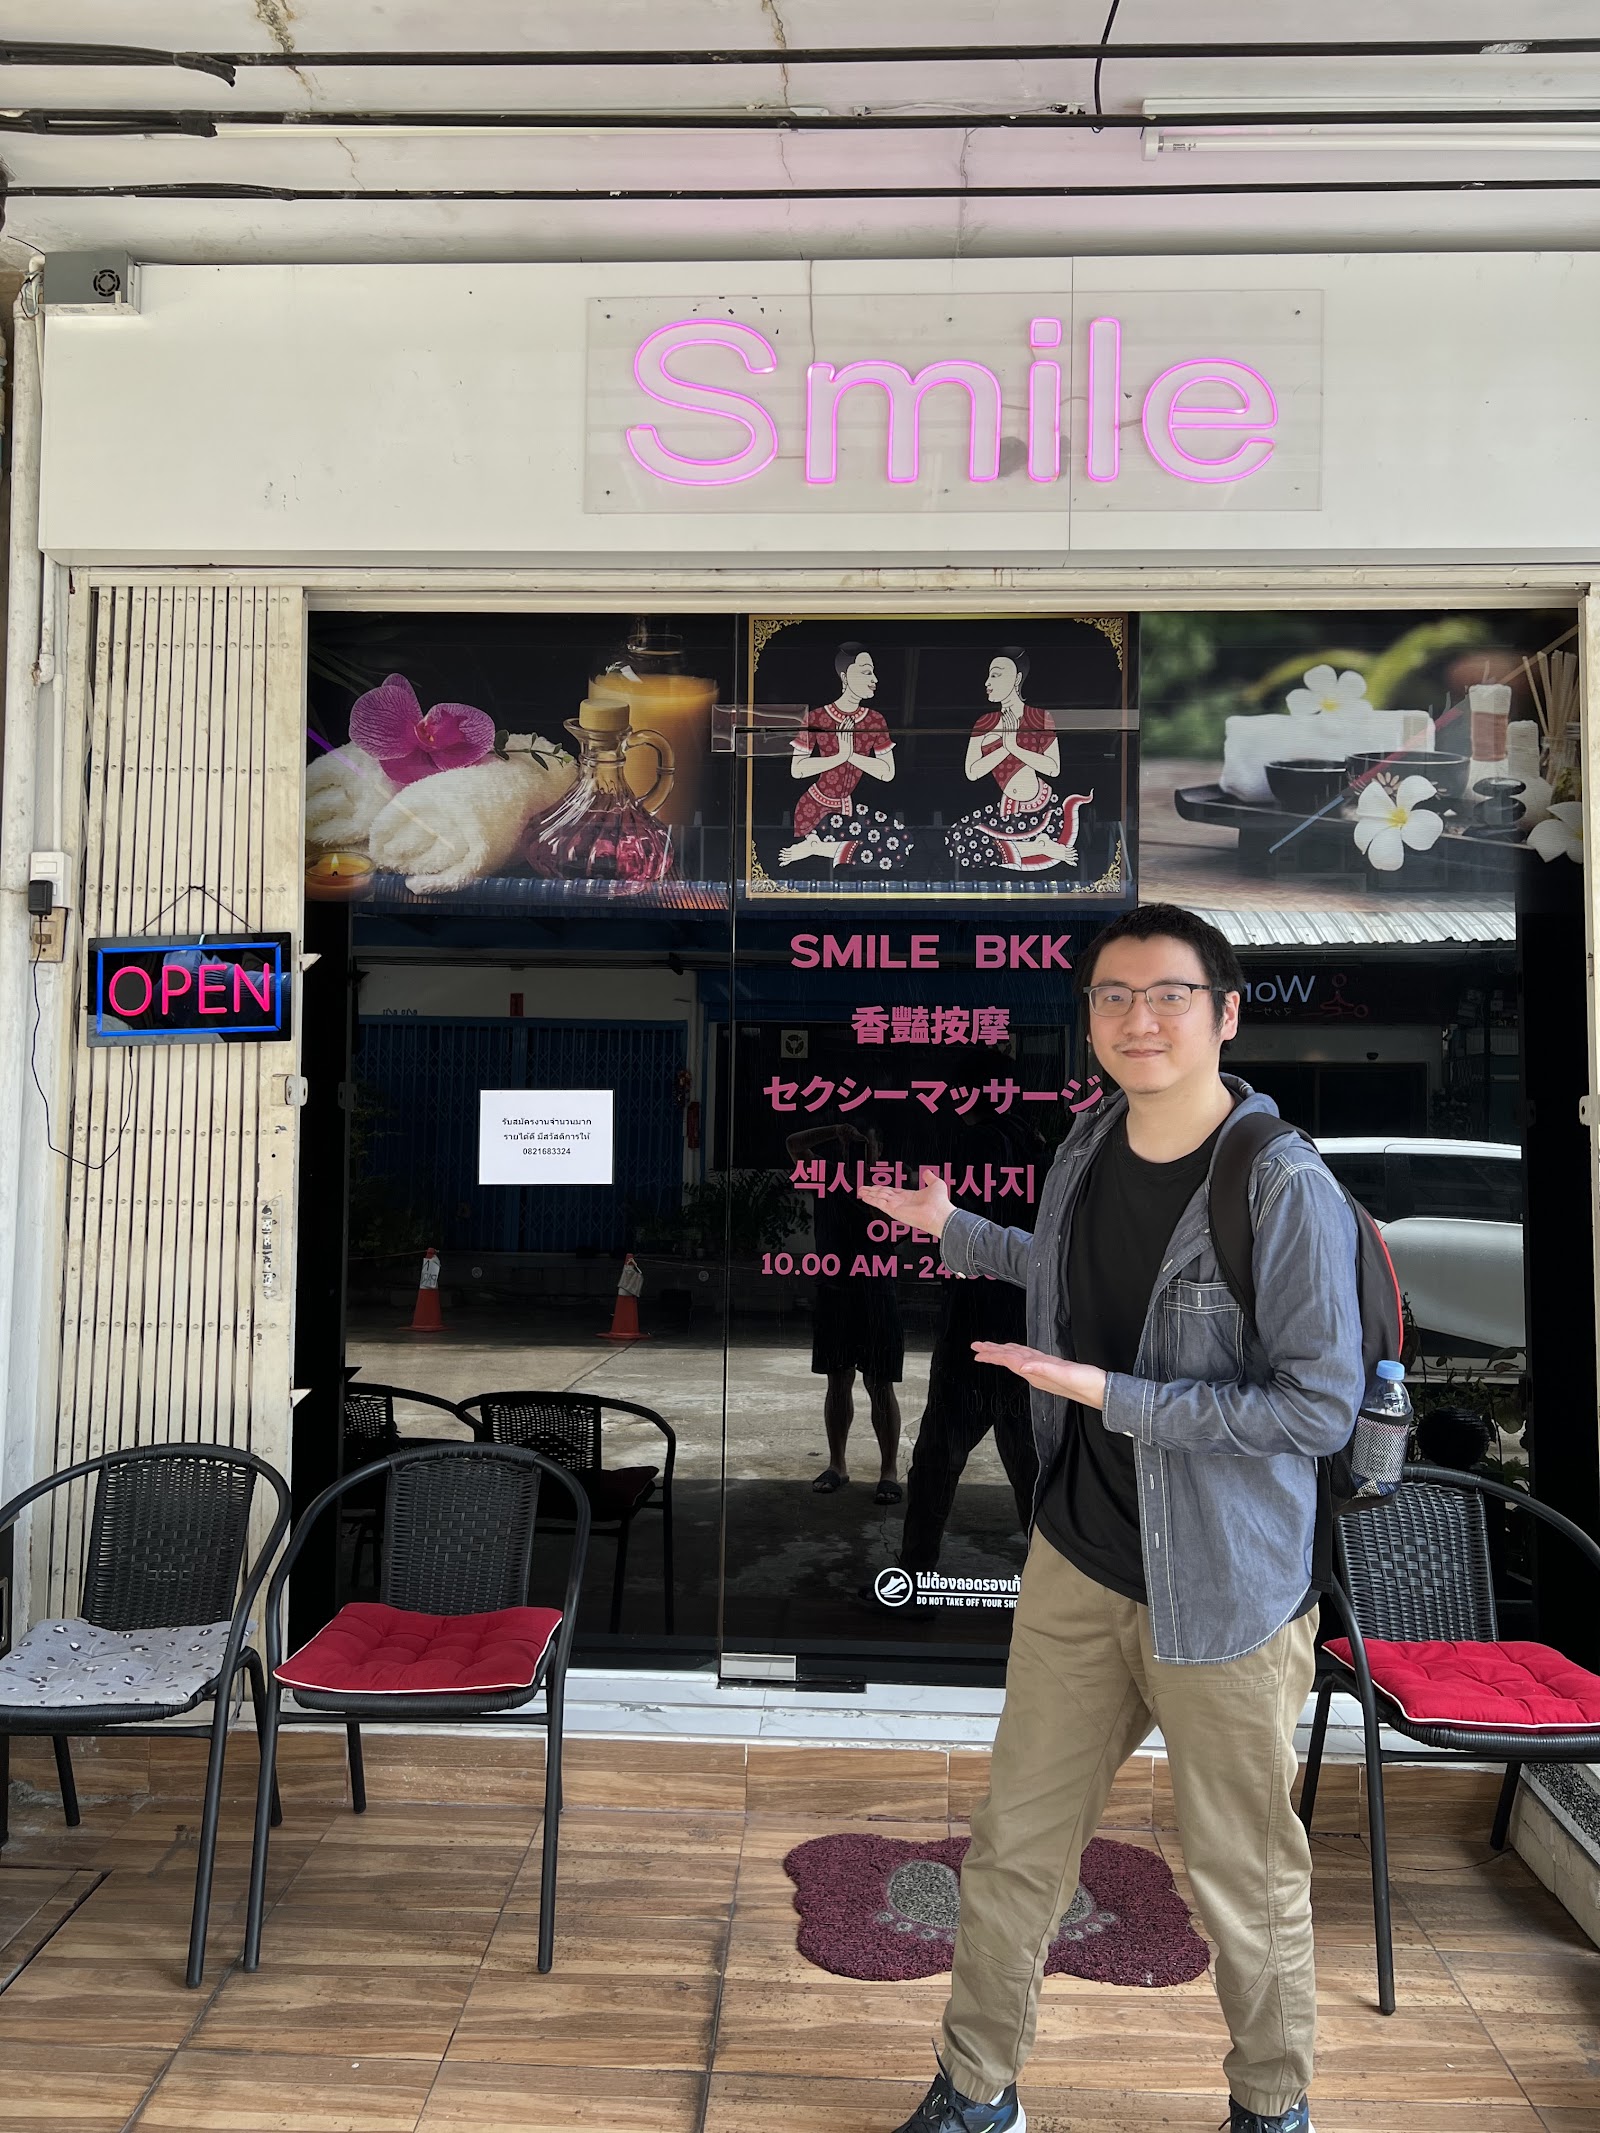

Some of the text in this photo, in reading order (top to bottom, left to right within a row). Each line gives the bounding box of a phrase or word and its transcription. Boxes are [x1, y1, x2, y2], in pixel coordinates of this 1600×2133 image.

[625, 317, 1280, 487] Smile
[790, 934, 1072, 969] SMILE BKK
[109, 962, 271, 1017] OPEN
[763, 1076, 1104, 1114] セクシーマッサージ
[522, 1147, 571, 1155] 0821683324
[867, 1219, 940, 1243] OPE
[761, 1253, 841, 1276] 10.00
[916, 1596, 927, 1605] DO
[929, 1597, 944, 1606] NOT
[945, 1597, 964, 1607] TAKE
[966, 1599, 980, 1607] OFF
[981, 1599, 1002, 1608] YOUR
